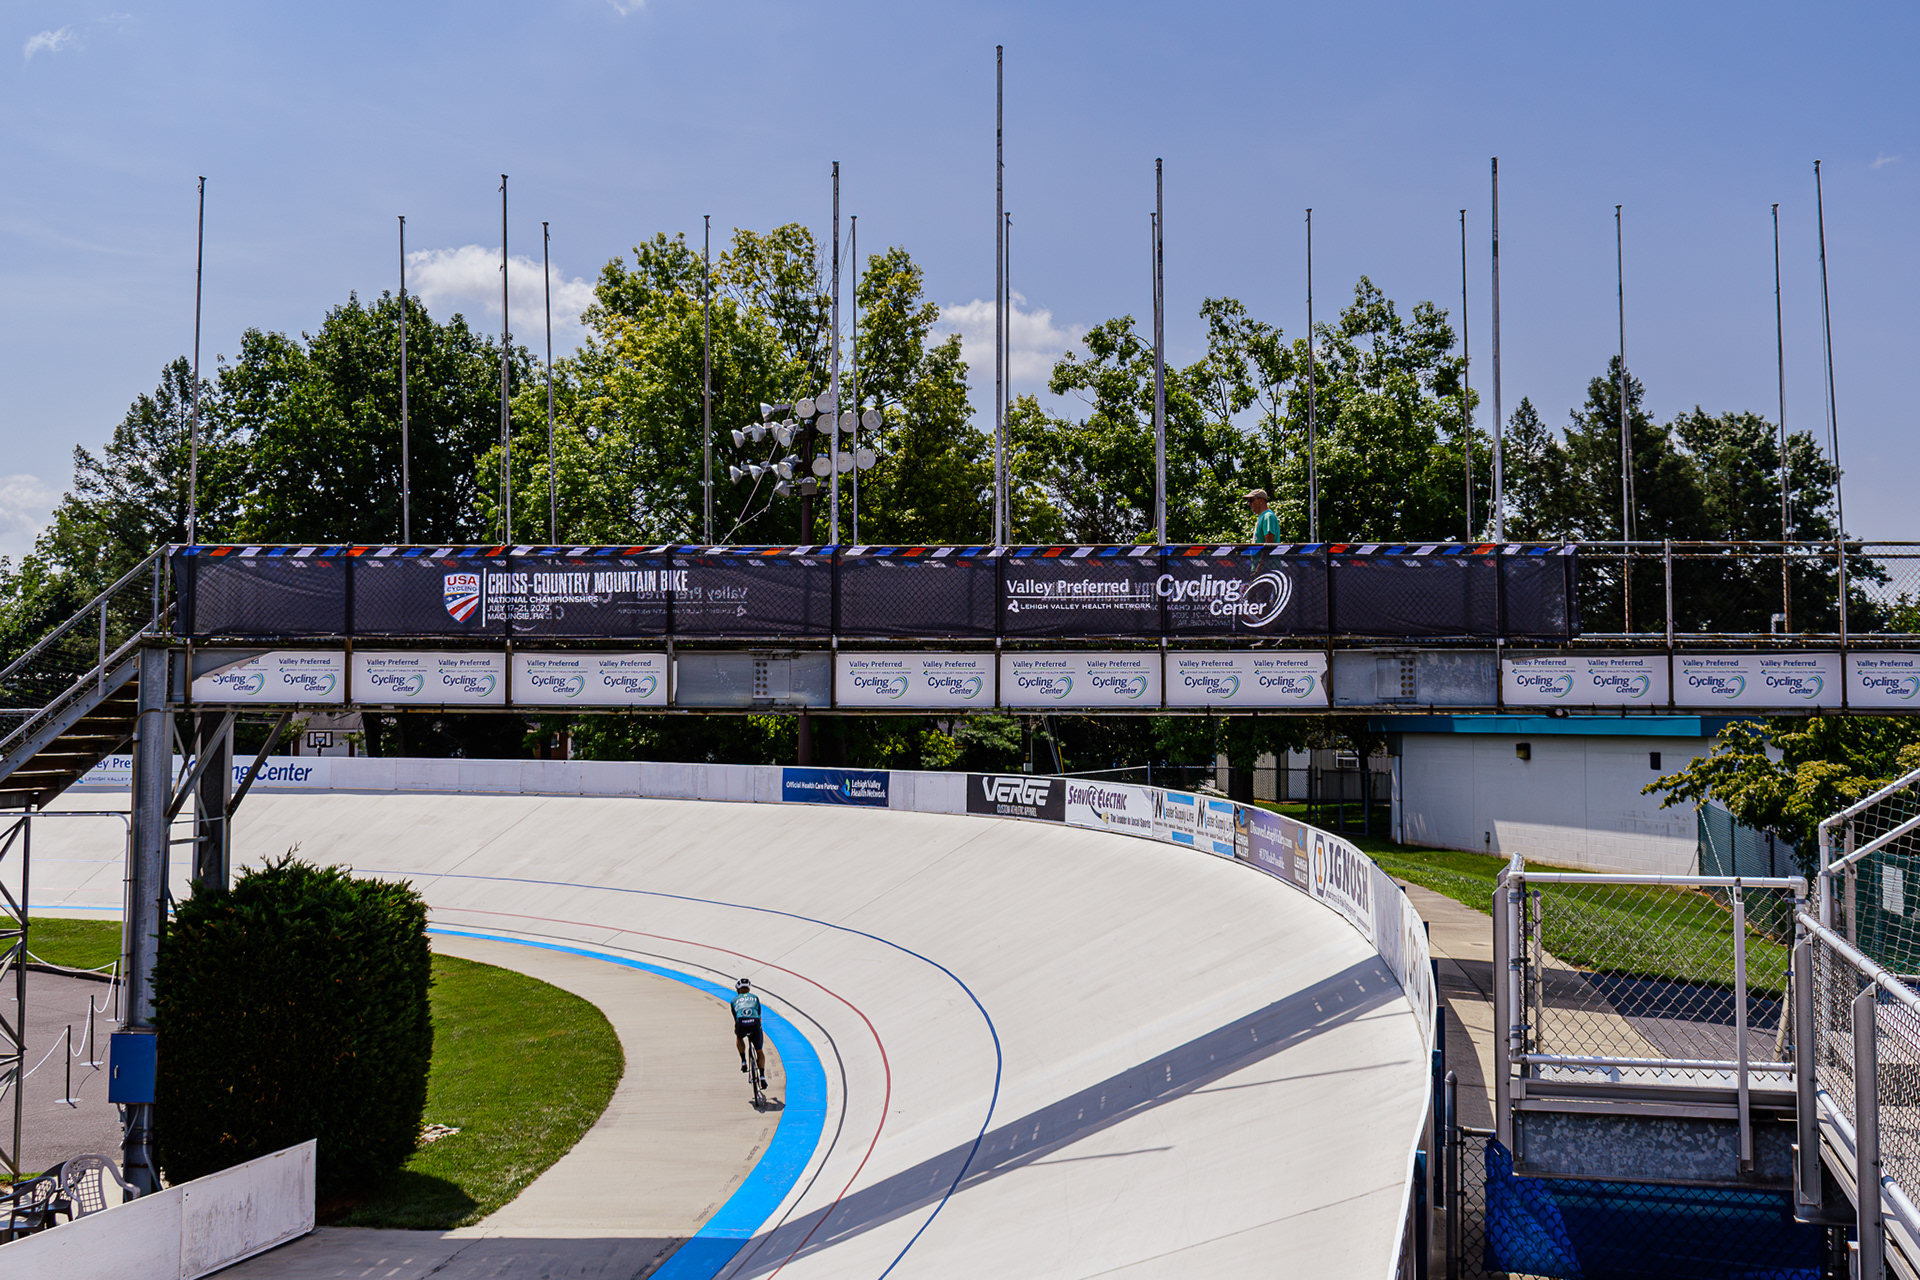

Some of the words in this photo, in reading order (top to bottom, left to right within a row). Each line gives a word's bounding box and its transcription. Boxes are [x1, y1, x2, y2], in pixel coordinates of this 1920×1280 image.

[447, 575, 477, 586] USA
[488, 573, 590, 594] CROSS-COUNTRY
[594, 570, 656, 593] MOUNTAIN
[660, 570, 688, 592] BIKE
[1007, 579, 1052, 597] Valley
[1057, 578, 1129, 594] Preferred
[1156, 574, 1242, 602] Cycling
[487, 604, 505, 612] JULY
[530, 604, 550, 612] 2024
[1209, 599, 1267, 616] Center
[487, 612, 532, 620] MACUNGIE,
[279, 658, 297, 666] Valley
[438, 659, 457, 667] Valley
[1588, 659, 1608, 667] Valley
[283, 674, 318, 685] Cycling
[372, 674, 406, 686] Cycling
[443, 675, 477, 686] Cycling
[532, 675, 566, 687] Cycling
[604, 676, 638, 687] Cycling
[854, 676, 889, 688] Cycling
[928, 676, 963, 688] Cycling
[1017, 676, 1053, 688] Cycling
[1092, 676, 1127, 688] Cycling
[1184, 676, 1220, 687] Cycling
[1259, 675, 1295, 687] Cycling
[1517, 674, 1553, 686] Cycling
[1593, 675, 1629, 686] Cycling
[1688, 675, 1725, 687] Cycling
[1766, 675, 1803, 687] Cycling
[1863, 675, 1899, 687] Cycling
[233, 683, 256, 691] Center
[392, 684, 415, 692] Center
[552, 685, 575, 693] Center
[875, 686, 898, 694] Center
[948, 686, 972, 694] Center
[1039, 686, 1062, 694] Center
[1113, 686, 1136, 694] Center
[1205, 685, 1229, 693] Center
[1280, 685, 1304, 693] Center
[1539, 685, 1563, 693] Center
[1711, 686, 1735, 694] Center
[1788, 686, 1813, 694] Center
[1885, 686, 1909, 694] Center
[256, 762, 313, 782] Center
[824, 783, 839, 791] Partner
[851, 779, 867, 791] Lehigh
[867, 780, 882, 790] Valley
[851, 788, 867, 797] Health
[867, 789, 886, 798] Network
[982, 776, 1052, 806] VERGE
[1329, 842, 1369, 914] IGNOSH
